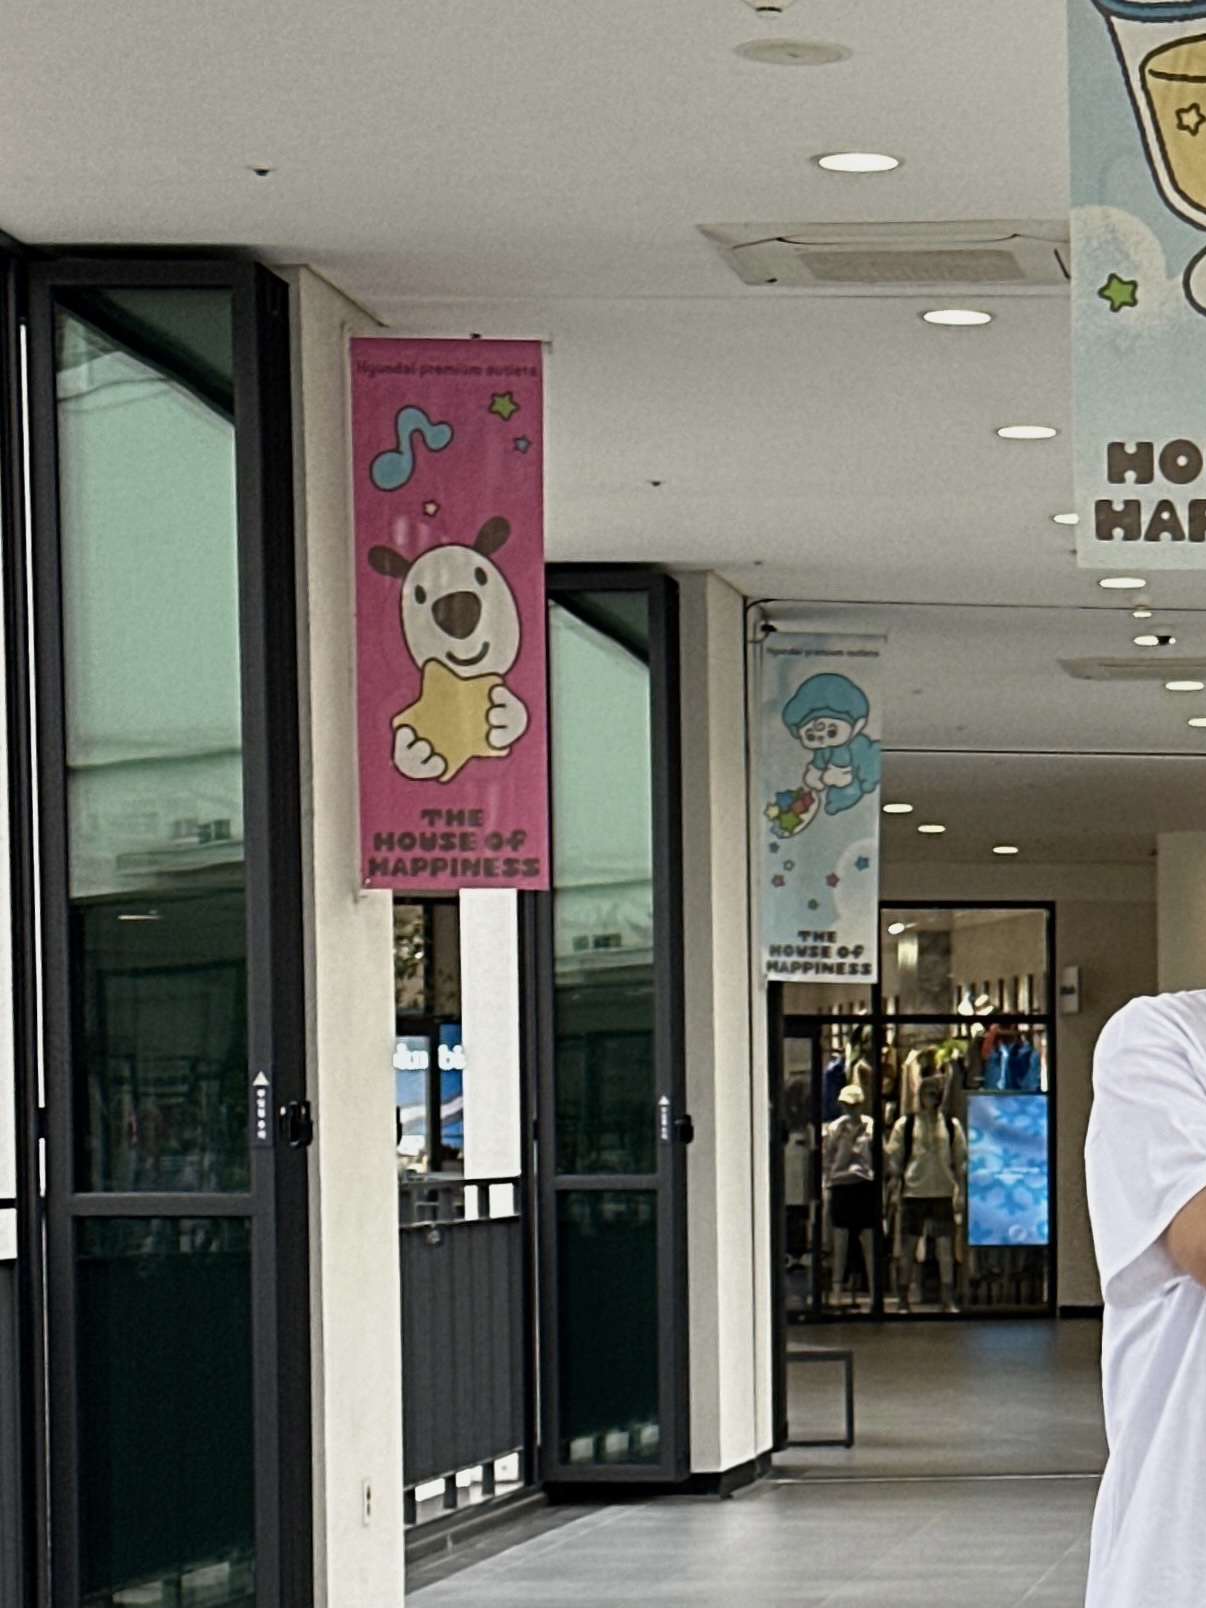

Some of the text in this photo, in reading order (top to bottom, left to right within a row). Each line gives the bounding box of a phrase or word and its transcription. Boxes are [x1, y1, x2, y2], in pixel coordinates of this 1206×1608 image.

[420, 809, 484, 827] THE
[373, 831, 477, 852] HOUSE
[368, 857, 541, 878] HAPPINESS
[797, 930, 837, 943] THE
[769, 944, 832, 959] HOUSE
[766, 960, 872, 976] HAPPINESS
